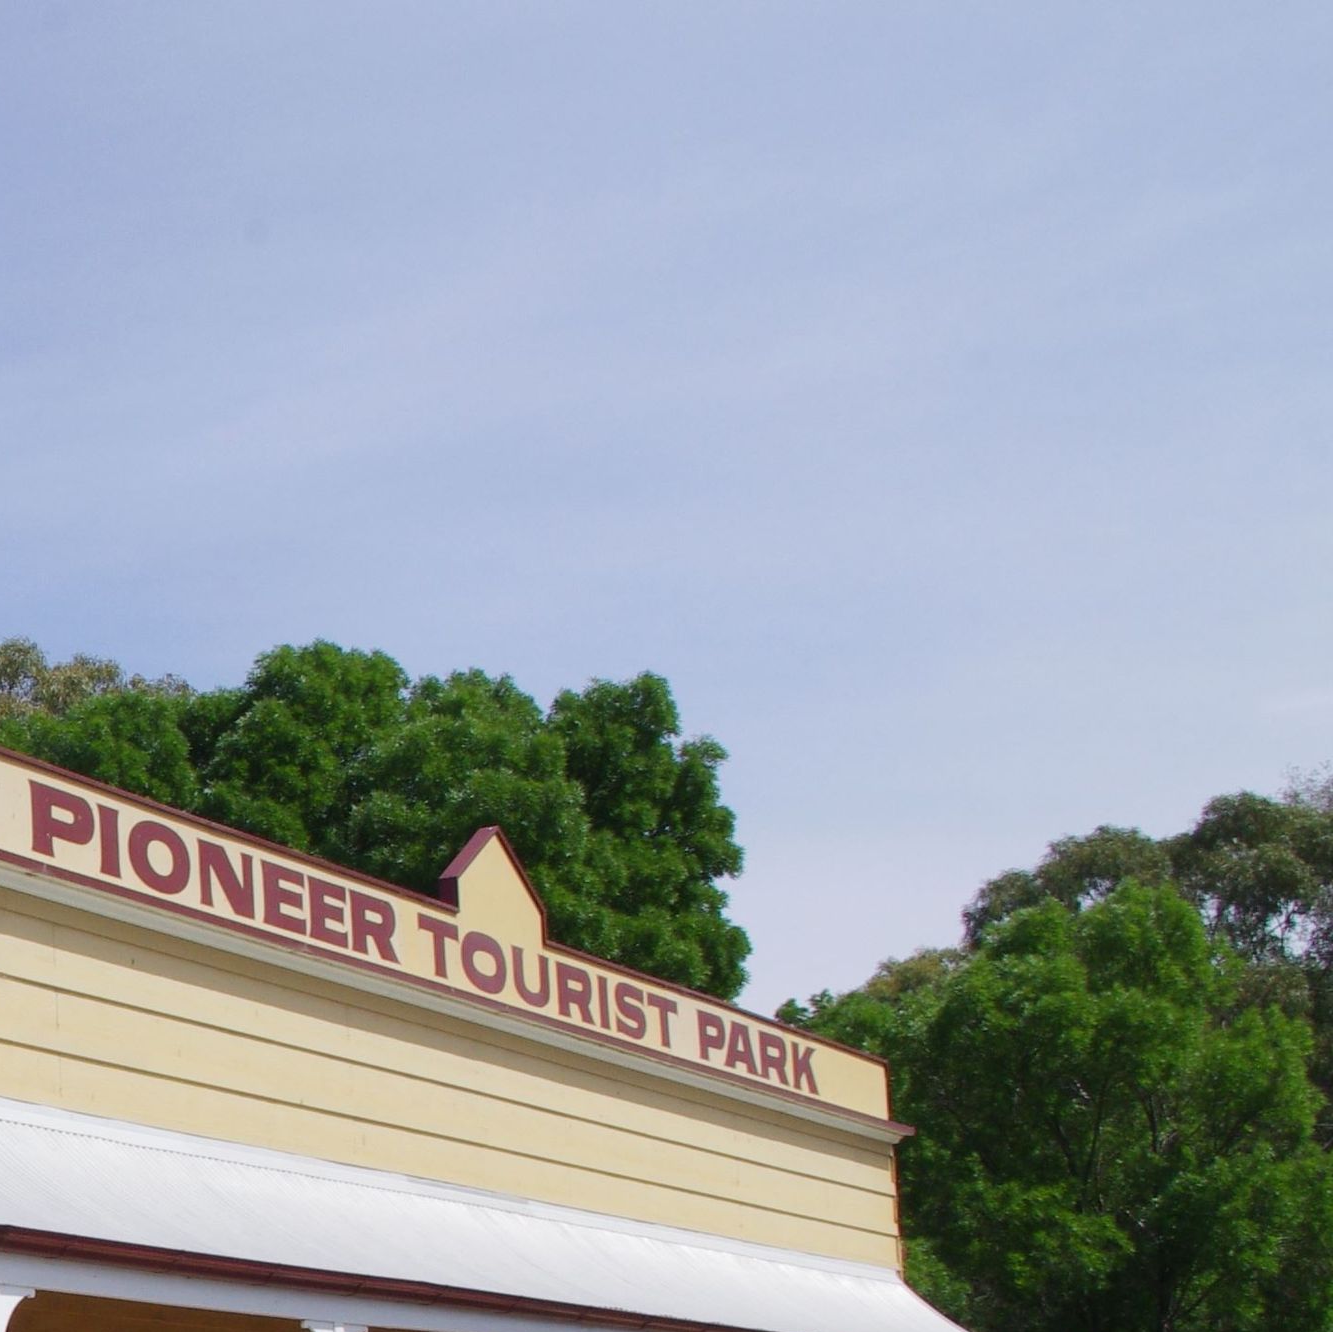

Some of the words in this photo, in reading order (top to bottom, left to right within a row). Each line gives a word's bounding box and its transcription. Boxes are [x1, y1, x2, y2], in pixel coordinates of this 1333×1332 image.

[28, 779, 400, 963] PIONEER
[417, 913, 679, 1050] TOURIST
[696, 1009, 821, 1096] PARK
